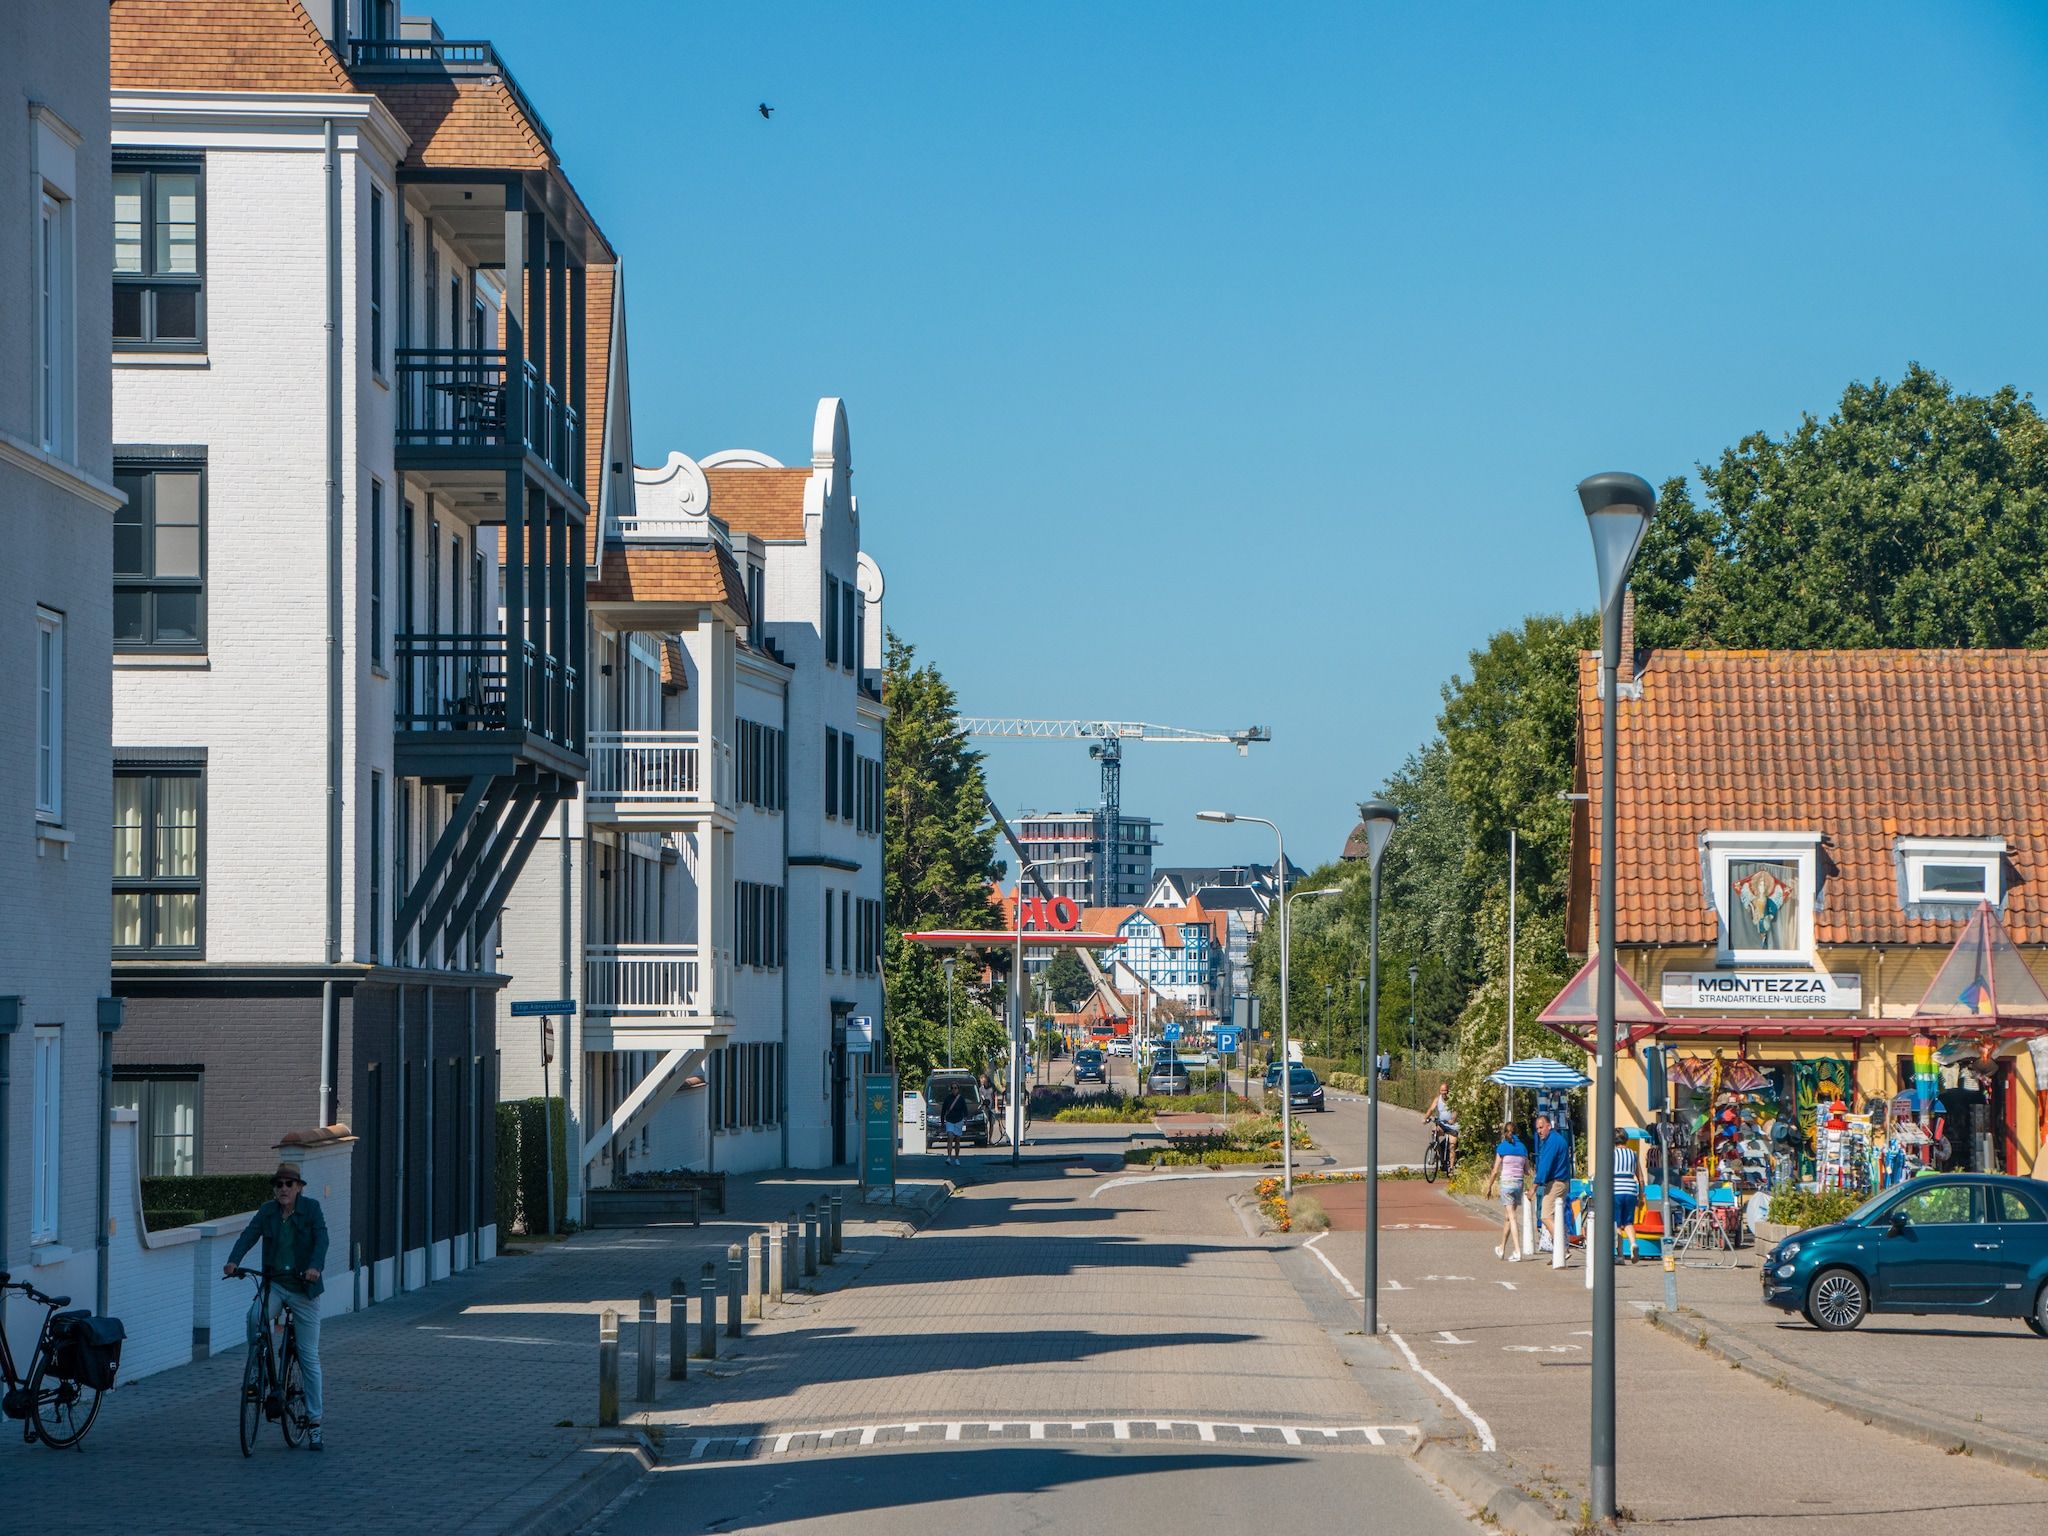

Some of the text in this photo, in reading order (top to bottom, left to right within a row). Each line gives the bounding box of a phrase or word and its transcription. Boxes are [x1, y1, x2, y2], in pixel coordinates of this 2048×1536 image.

[1698, 978, 1826, 992] MONTEZZA
[1699, 995, 1826, 1004] STRANDARTIKELEN-VLIEGERS
[1166, 1024, 1172, 1033] P
[1222, 1034, 1232, 1050] P
